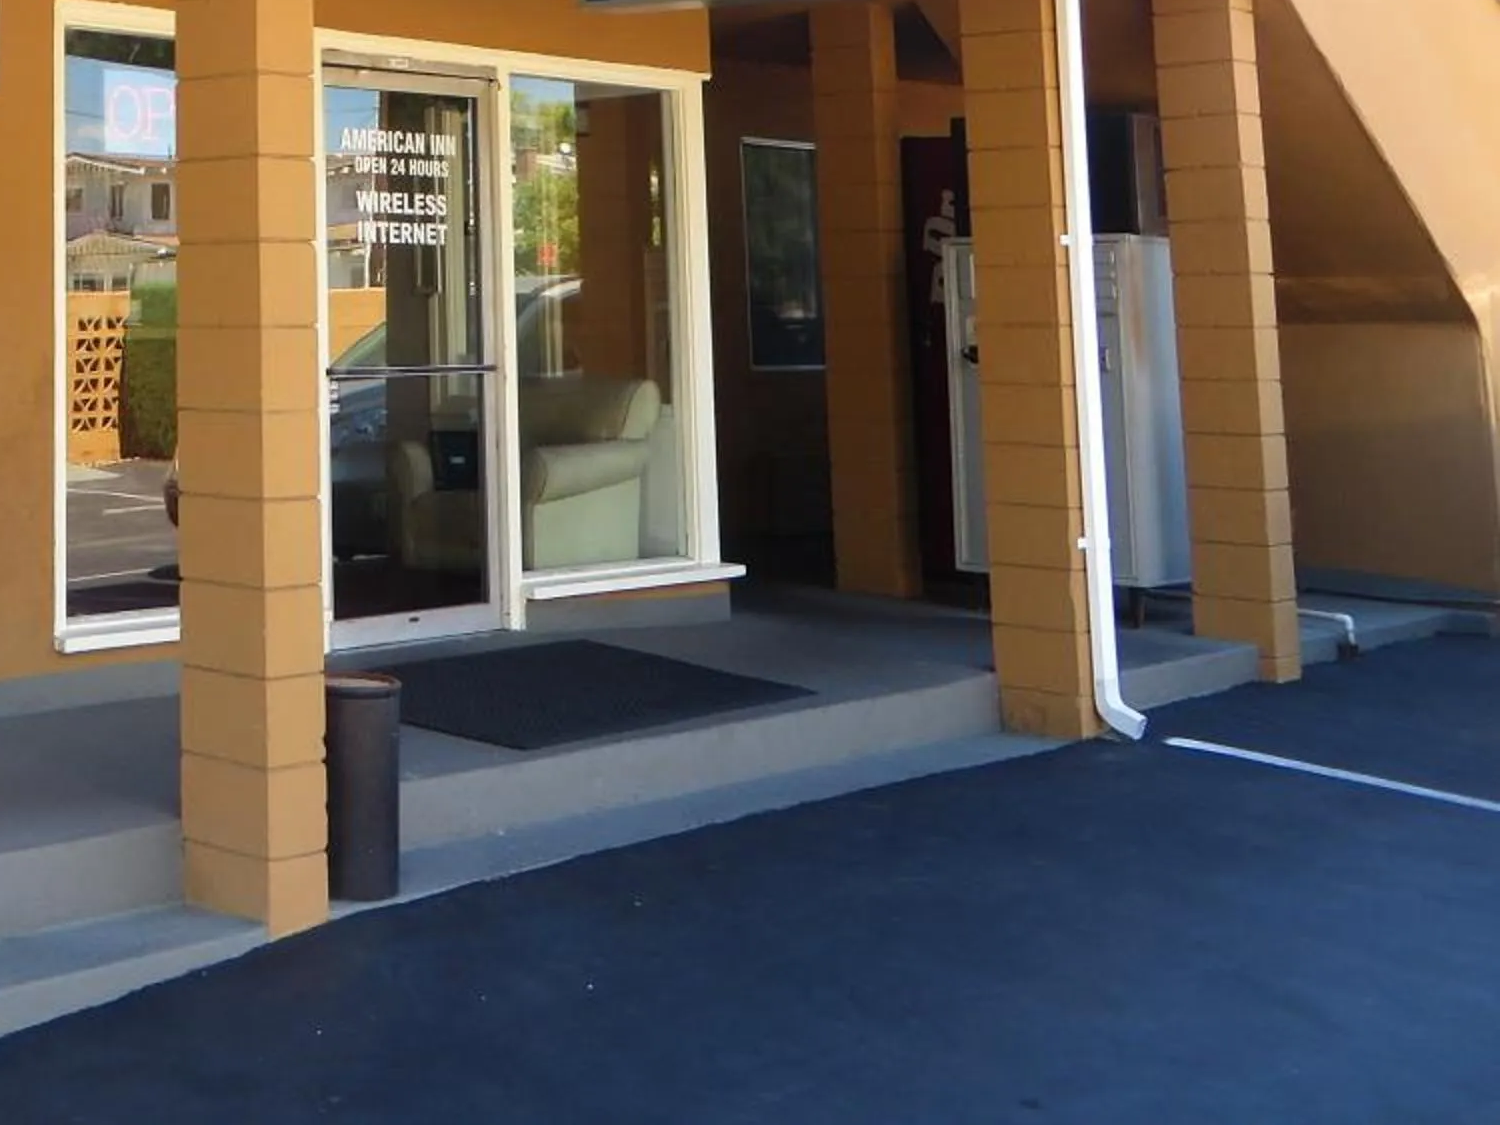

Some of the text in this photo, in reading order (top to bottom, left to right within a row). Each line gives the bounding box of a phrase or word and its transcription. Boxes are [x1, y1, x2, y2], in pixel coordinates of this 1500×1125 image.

[341, 127, 457, 156] AMERICAN INN
[355, 156, 449, 177] OPEN 24 HOURS
[356, 190, 448, 215] WIRELESS
[357, 220, 449, 245] INTERNET
